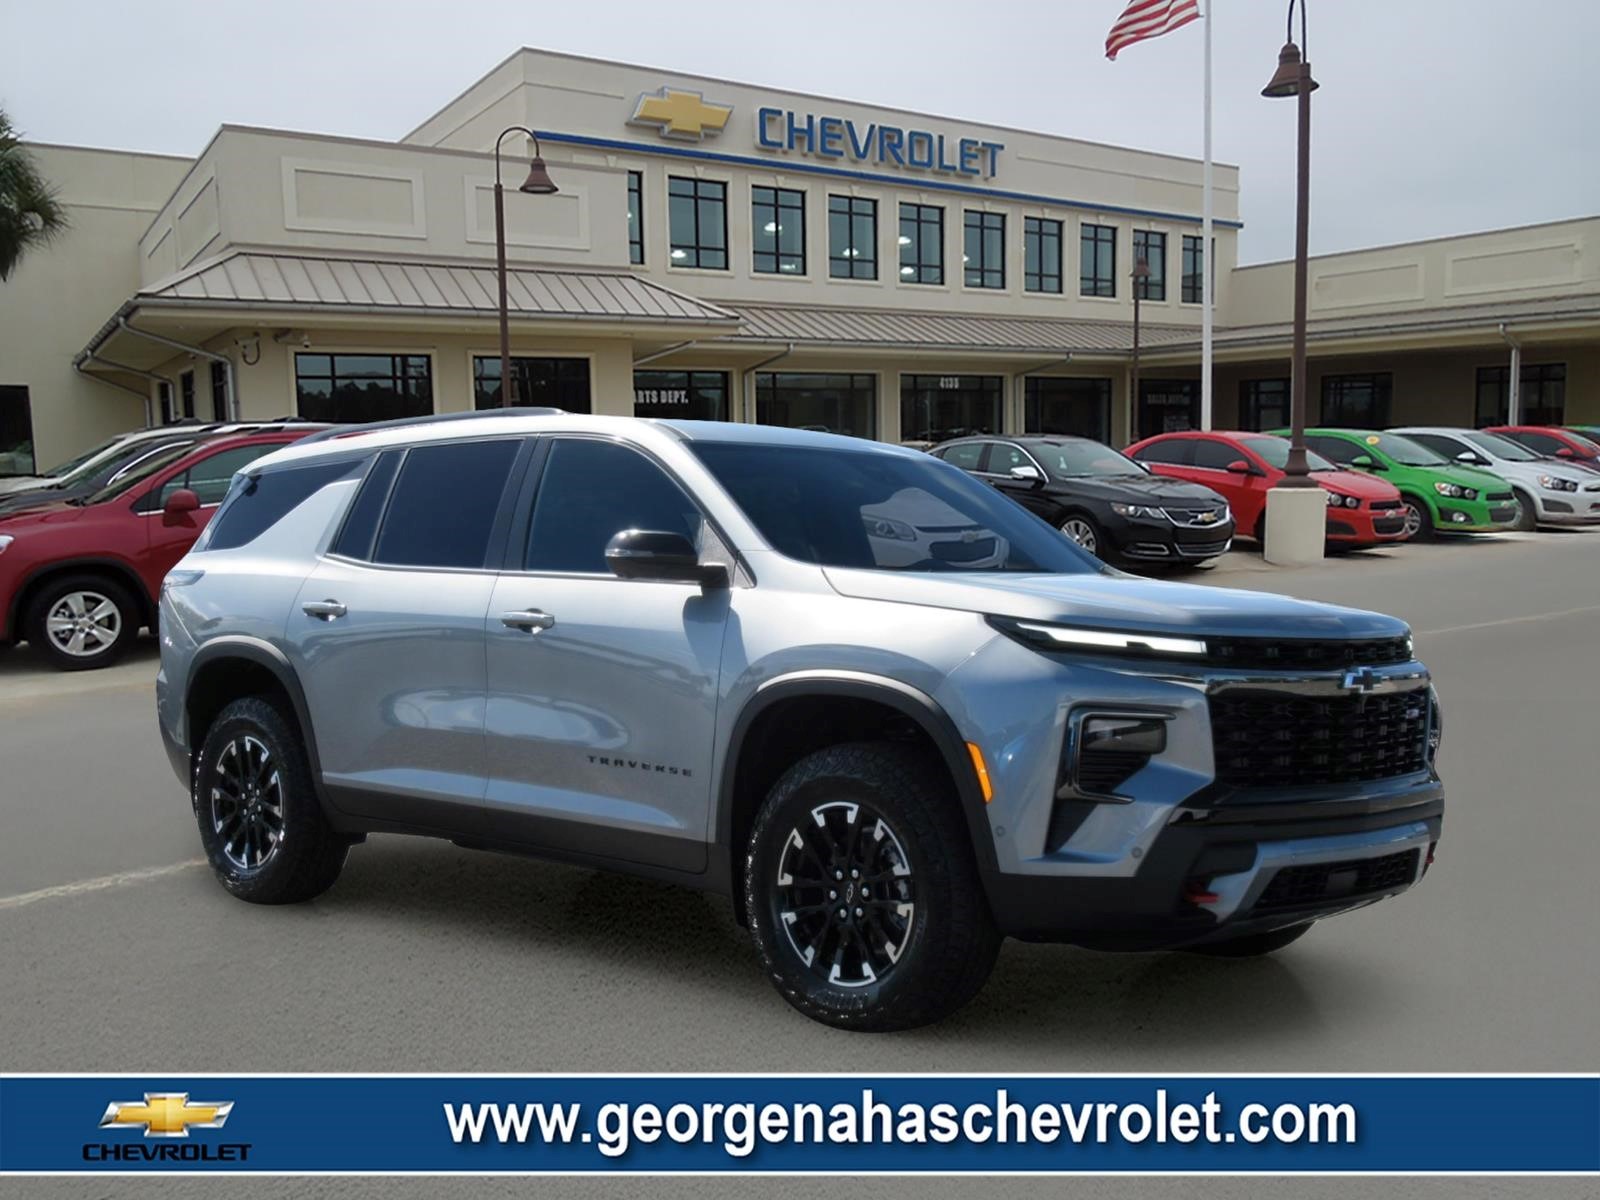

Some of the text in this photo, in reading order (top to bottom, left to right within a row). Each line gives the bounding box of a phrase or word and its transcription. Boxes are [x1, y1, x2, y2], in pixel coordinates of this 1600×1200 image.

[757, 106, 1005, 178] CHEVROLET
[660, 390, 689, 404] DEPT.
[587, 754, 693, 777] TRAVERSE
